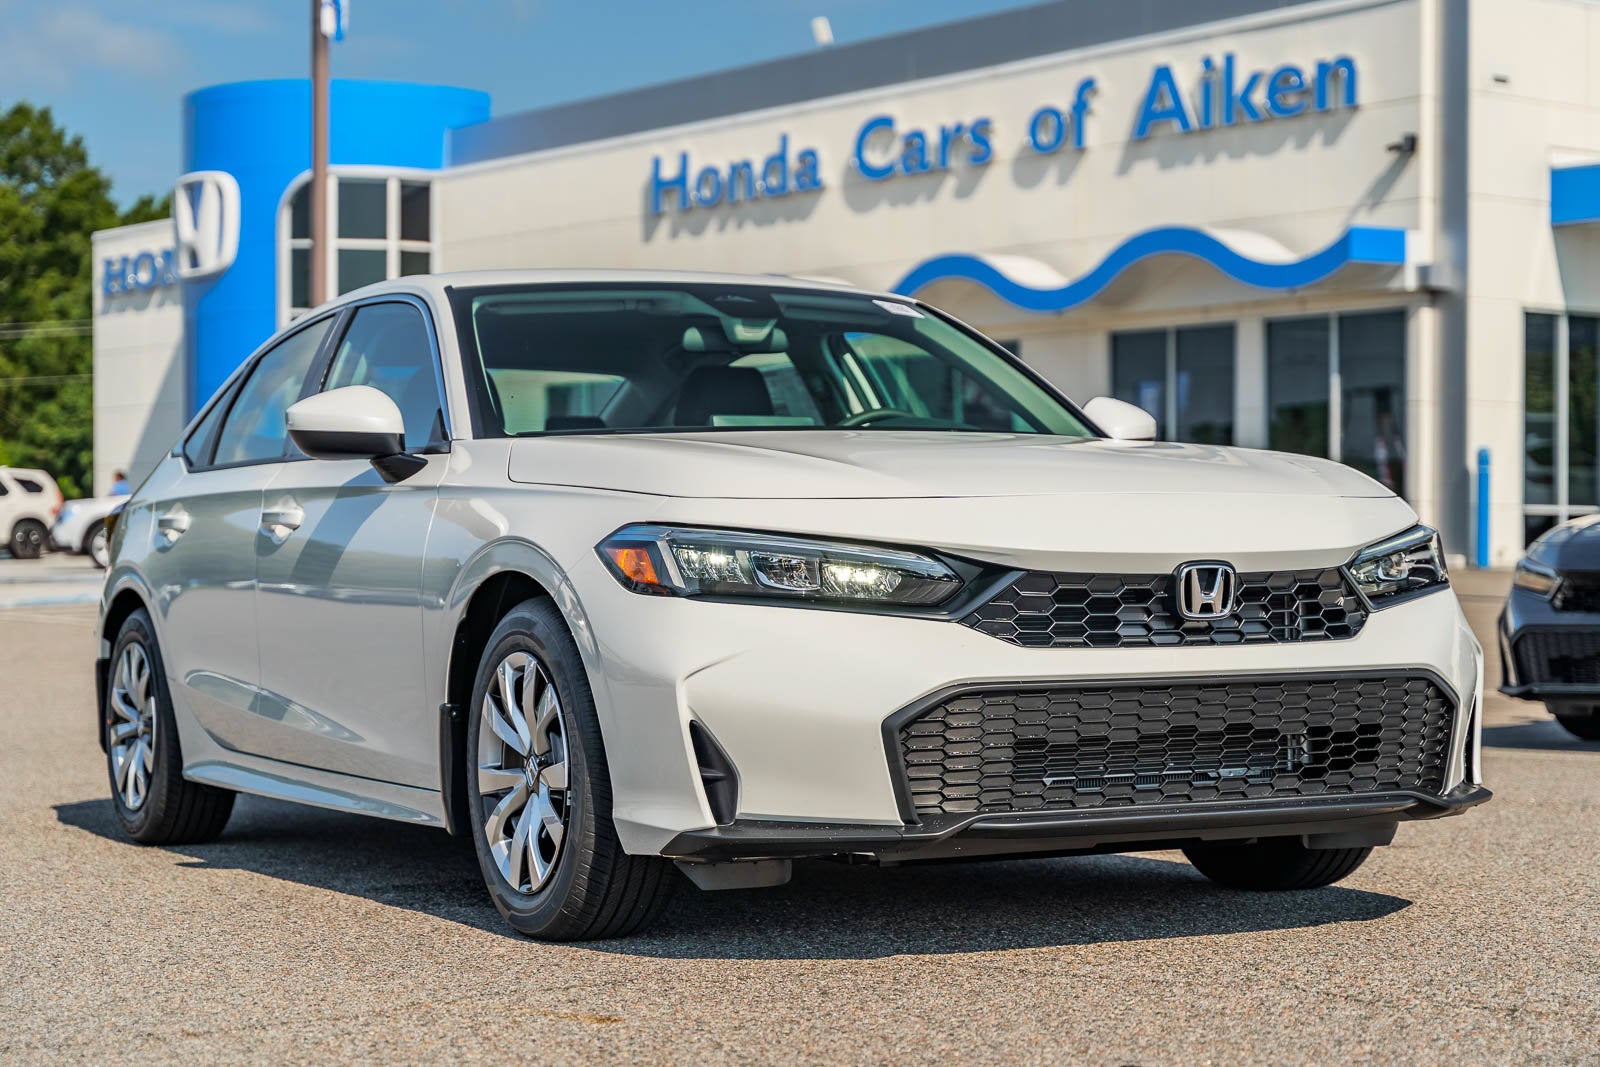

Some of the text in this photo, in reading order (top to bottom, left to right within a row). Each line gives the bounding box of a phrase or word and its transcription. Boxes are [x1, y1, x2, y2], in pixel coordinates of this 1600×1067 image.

[651, 53, 1358, 214] Honda Cars of Aiken
